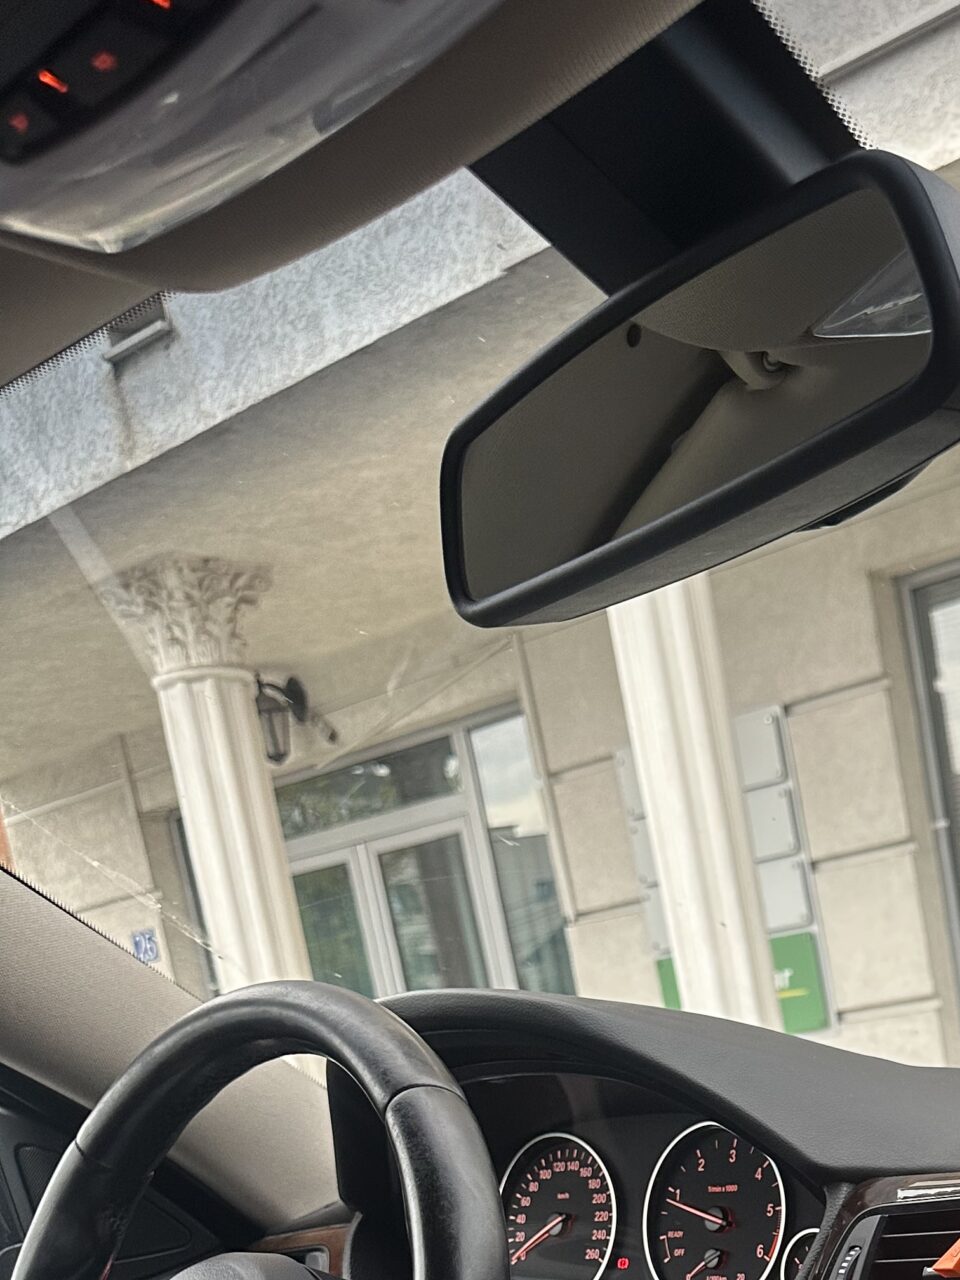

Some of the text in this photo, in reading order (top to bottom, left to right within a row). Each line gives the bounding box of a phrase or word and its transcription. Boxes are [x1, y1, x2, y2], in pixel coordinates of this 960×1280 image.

[728, 1149, 736, 1163] 3
[698, 1159, 705, 1172] 2
[754, 1167, 762, 1181] 4
[592, 1193, 607, 1204] 200
[675, 1189, 680, 1201] 1
[520, 1196, 531, 1207] 60
[766, 1203, 774, 1217] 5
[516, 1213, 527, 1225] 40
[594, 1211, 609, 1222] 220
[515, 1231, 526, 1242] 20
[591, 1229, 607, 1241] 240
[585, 1248, 600, 1260] 260
[673, 1248, 685, 1257] OFF
[756, 1244, 764, 1258] 6
